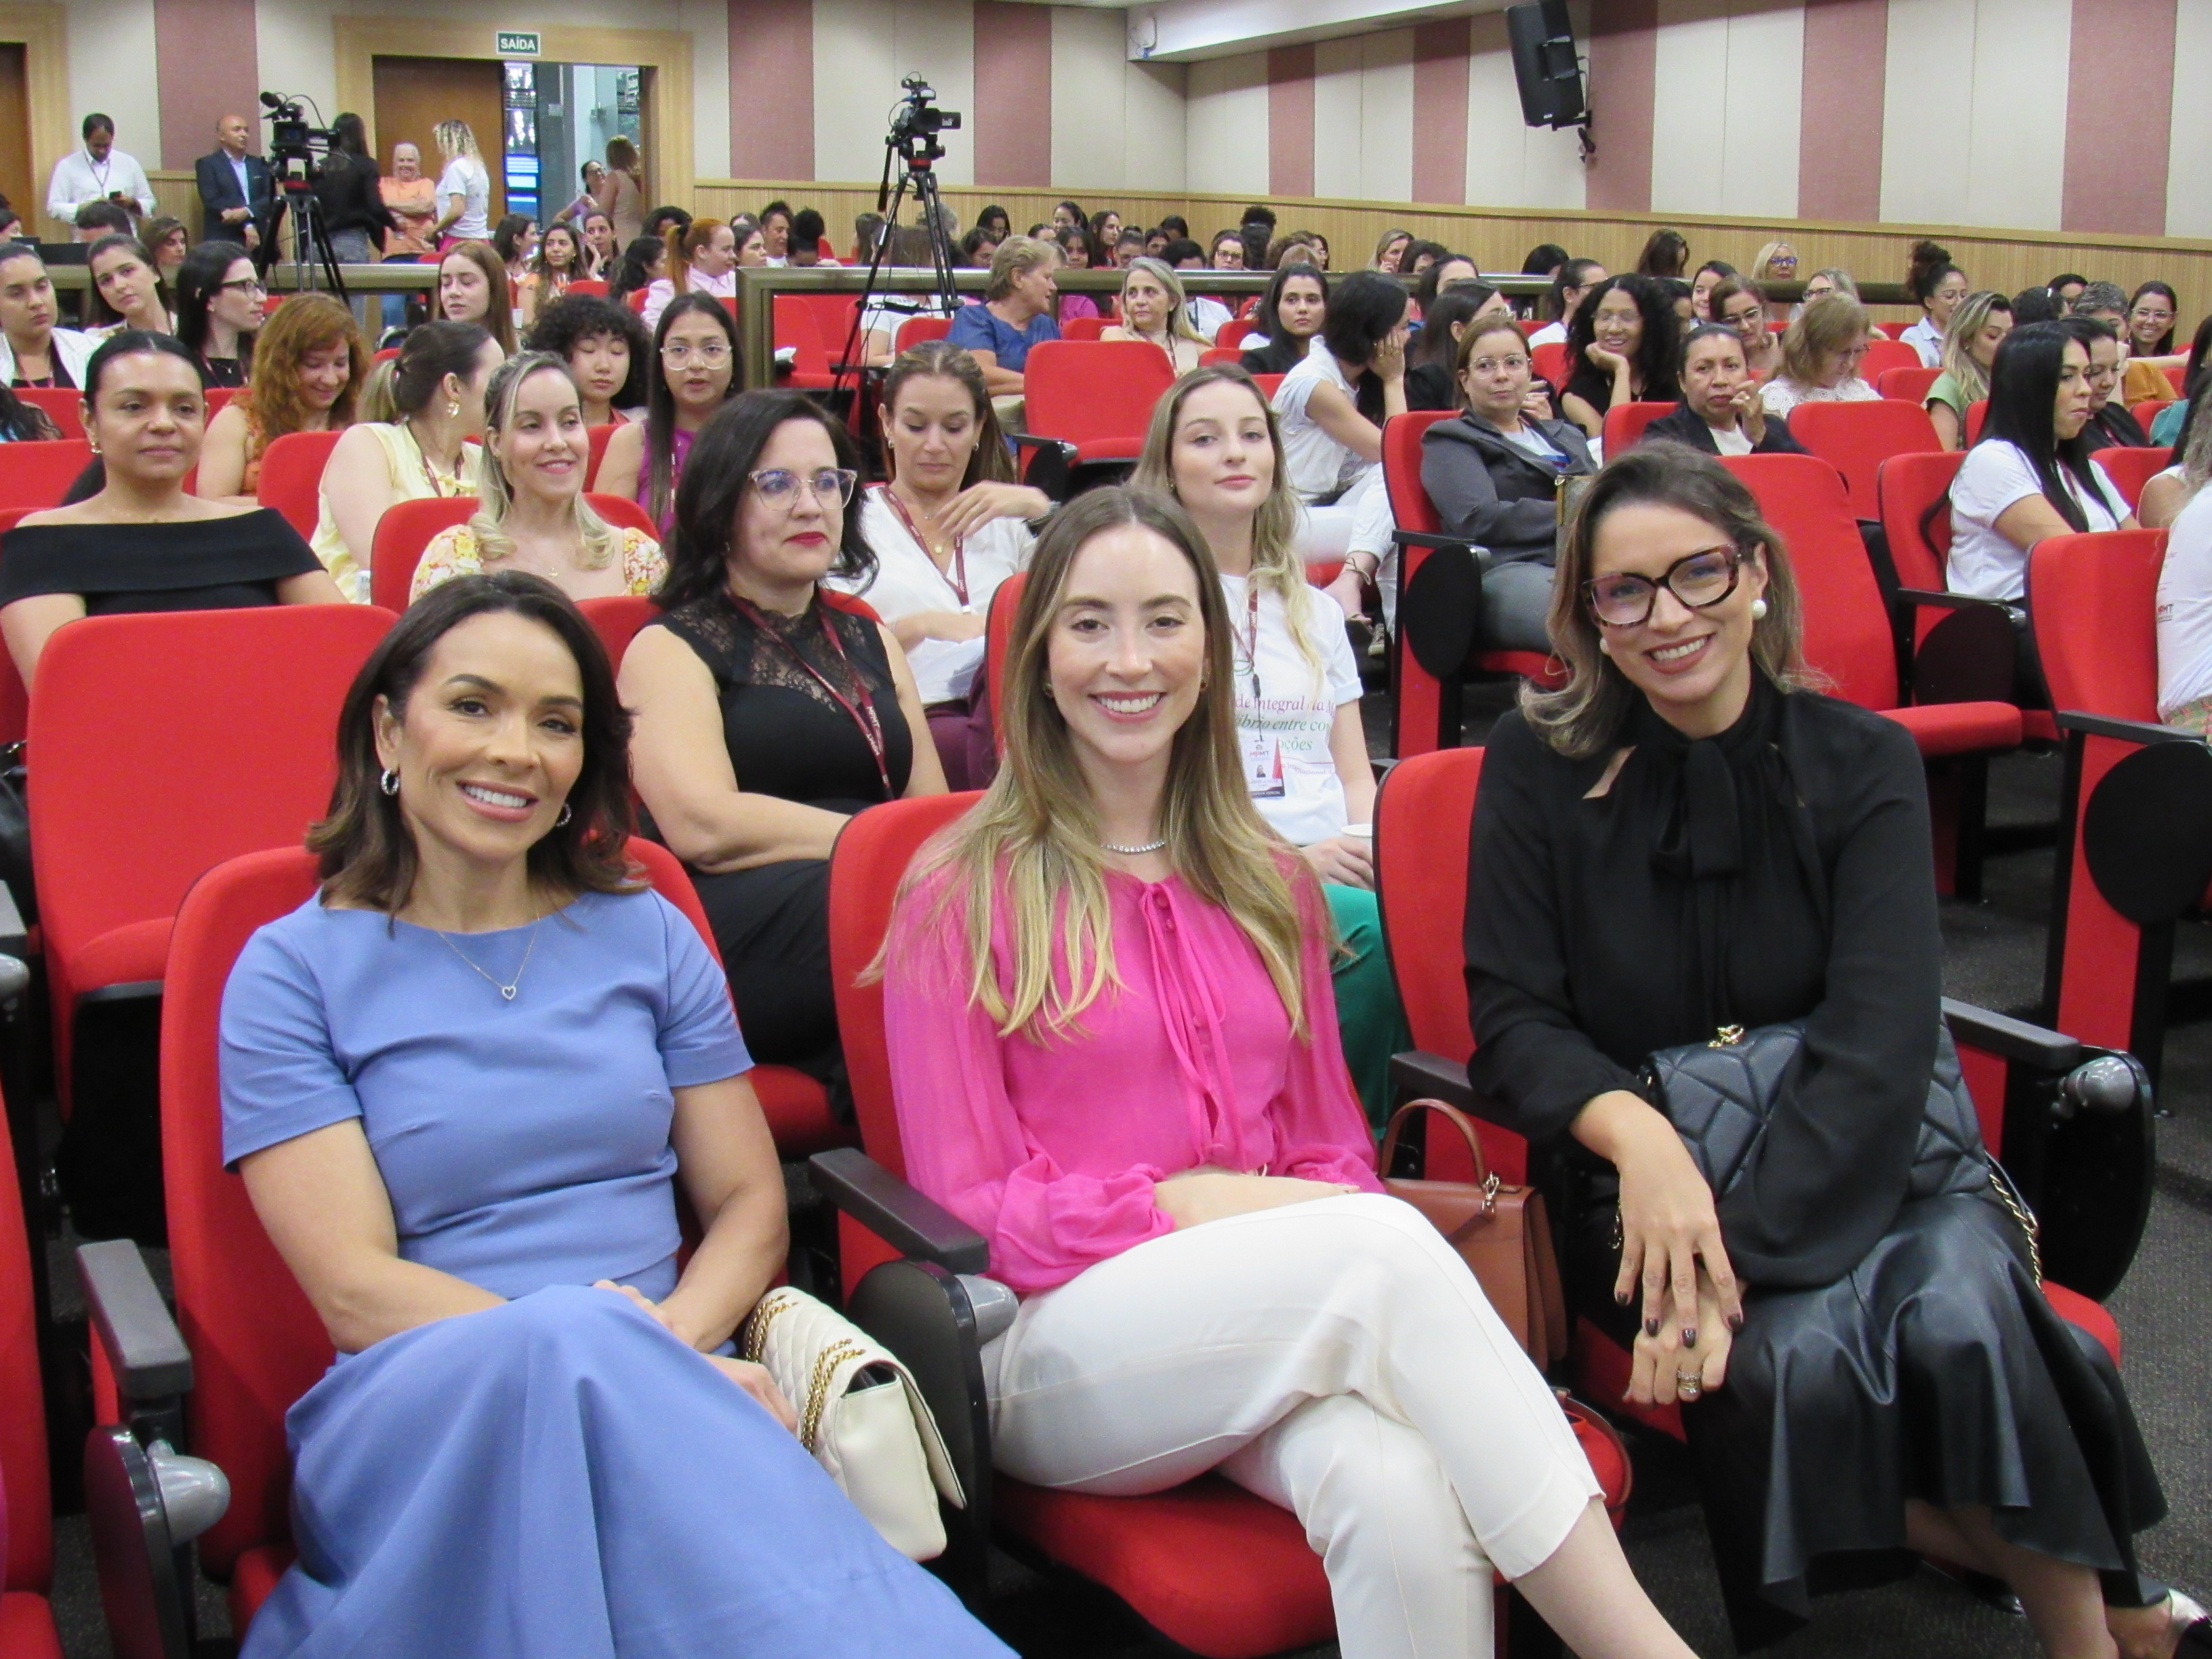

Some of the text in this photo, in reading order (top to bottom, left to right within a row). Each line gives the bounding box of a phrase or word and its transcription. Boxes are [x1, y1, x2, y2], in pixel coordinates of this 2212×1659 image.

[500, 36, 535, 51] SAÍDA
[1254, 695, 1305, 715] Integral
[867, 706, 880, 728] MPMT
[1272, 719, 1307, 731] entre
[865, 733, 880, 756] MPMT
[1278, 737, 1313, 753] oções
